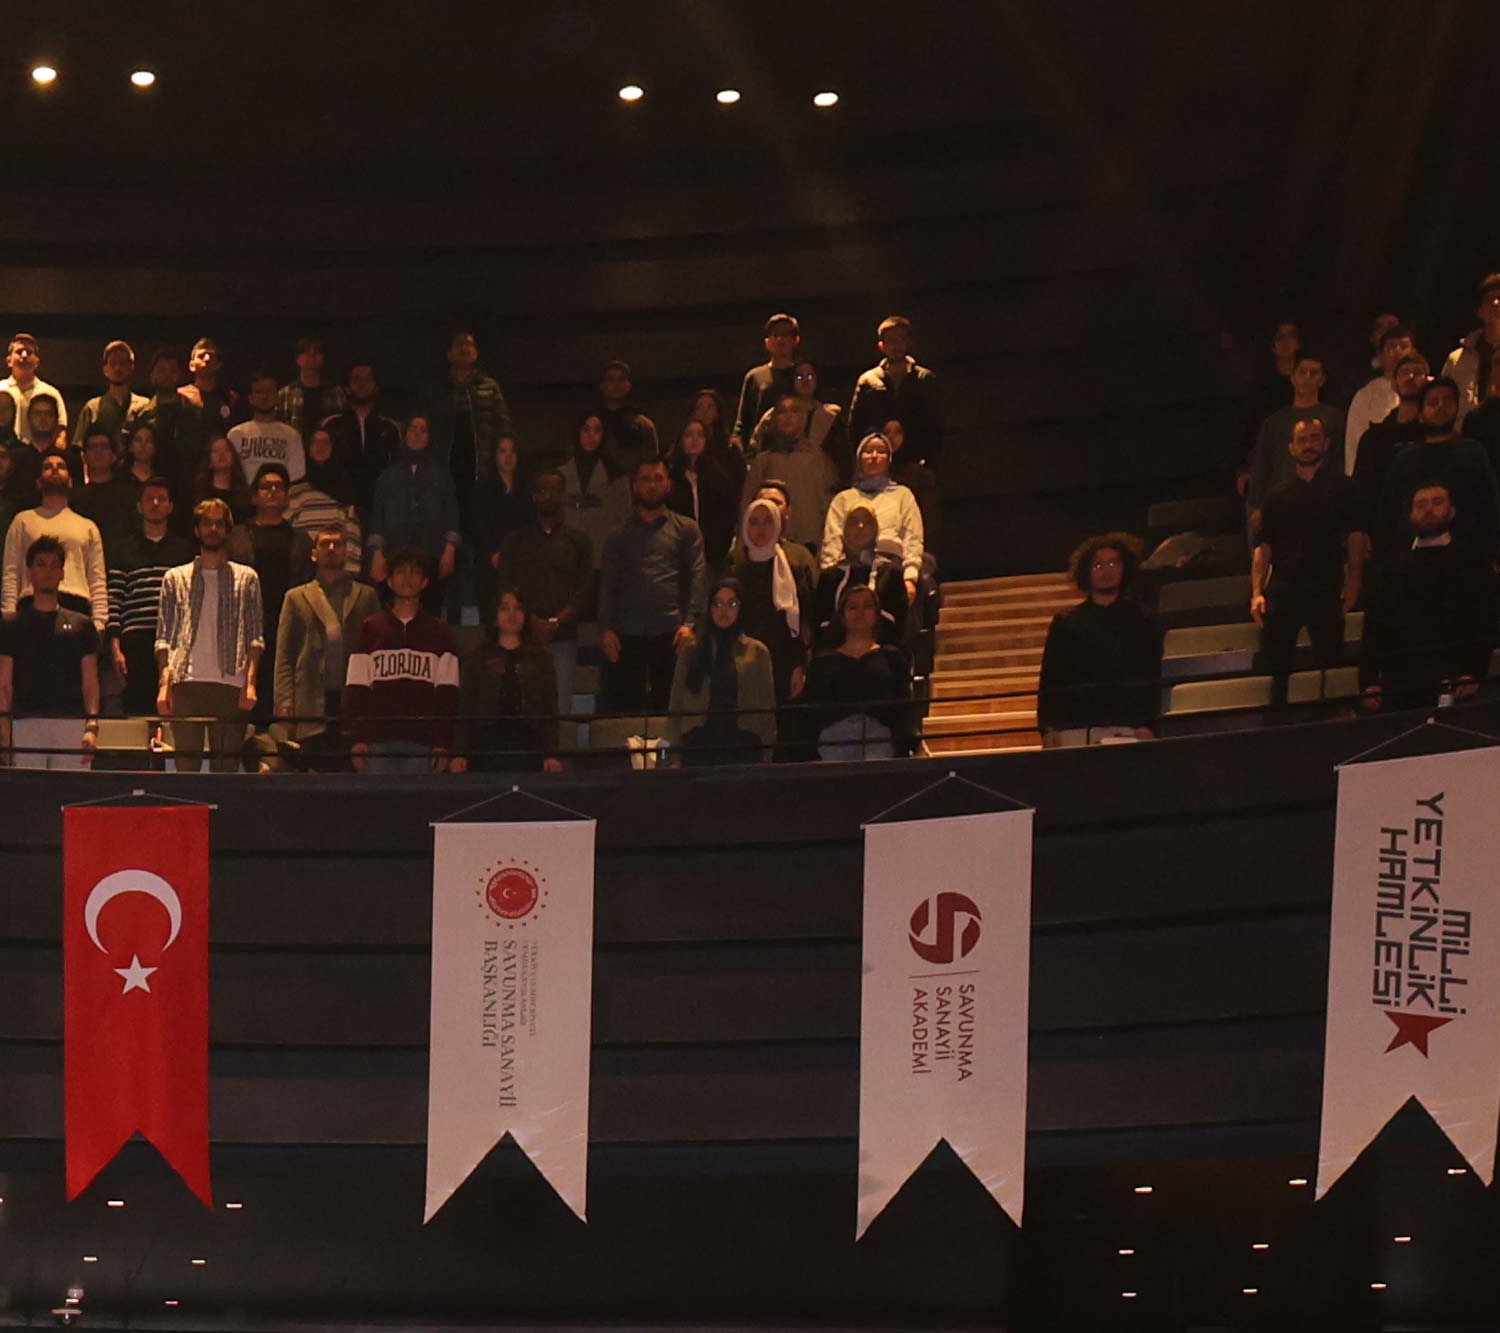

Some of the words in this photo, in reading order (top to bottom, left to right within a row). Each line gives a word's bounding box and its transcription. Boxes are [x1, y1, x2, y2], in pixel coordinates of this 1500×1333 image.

[373, 652, 431, 679] FLORIDA
[482, 940, 499, 1047] BAŞKANLIĞI
[501, 940, 517, 1031] SAVUNMA
[911, 987, 931, 1075] AKADEMİ
[957, 983, 976, 1082] SAVUNMA
